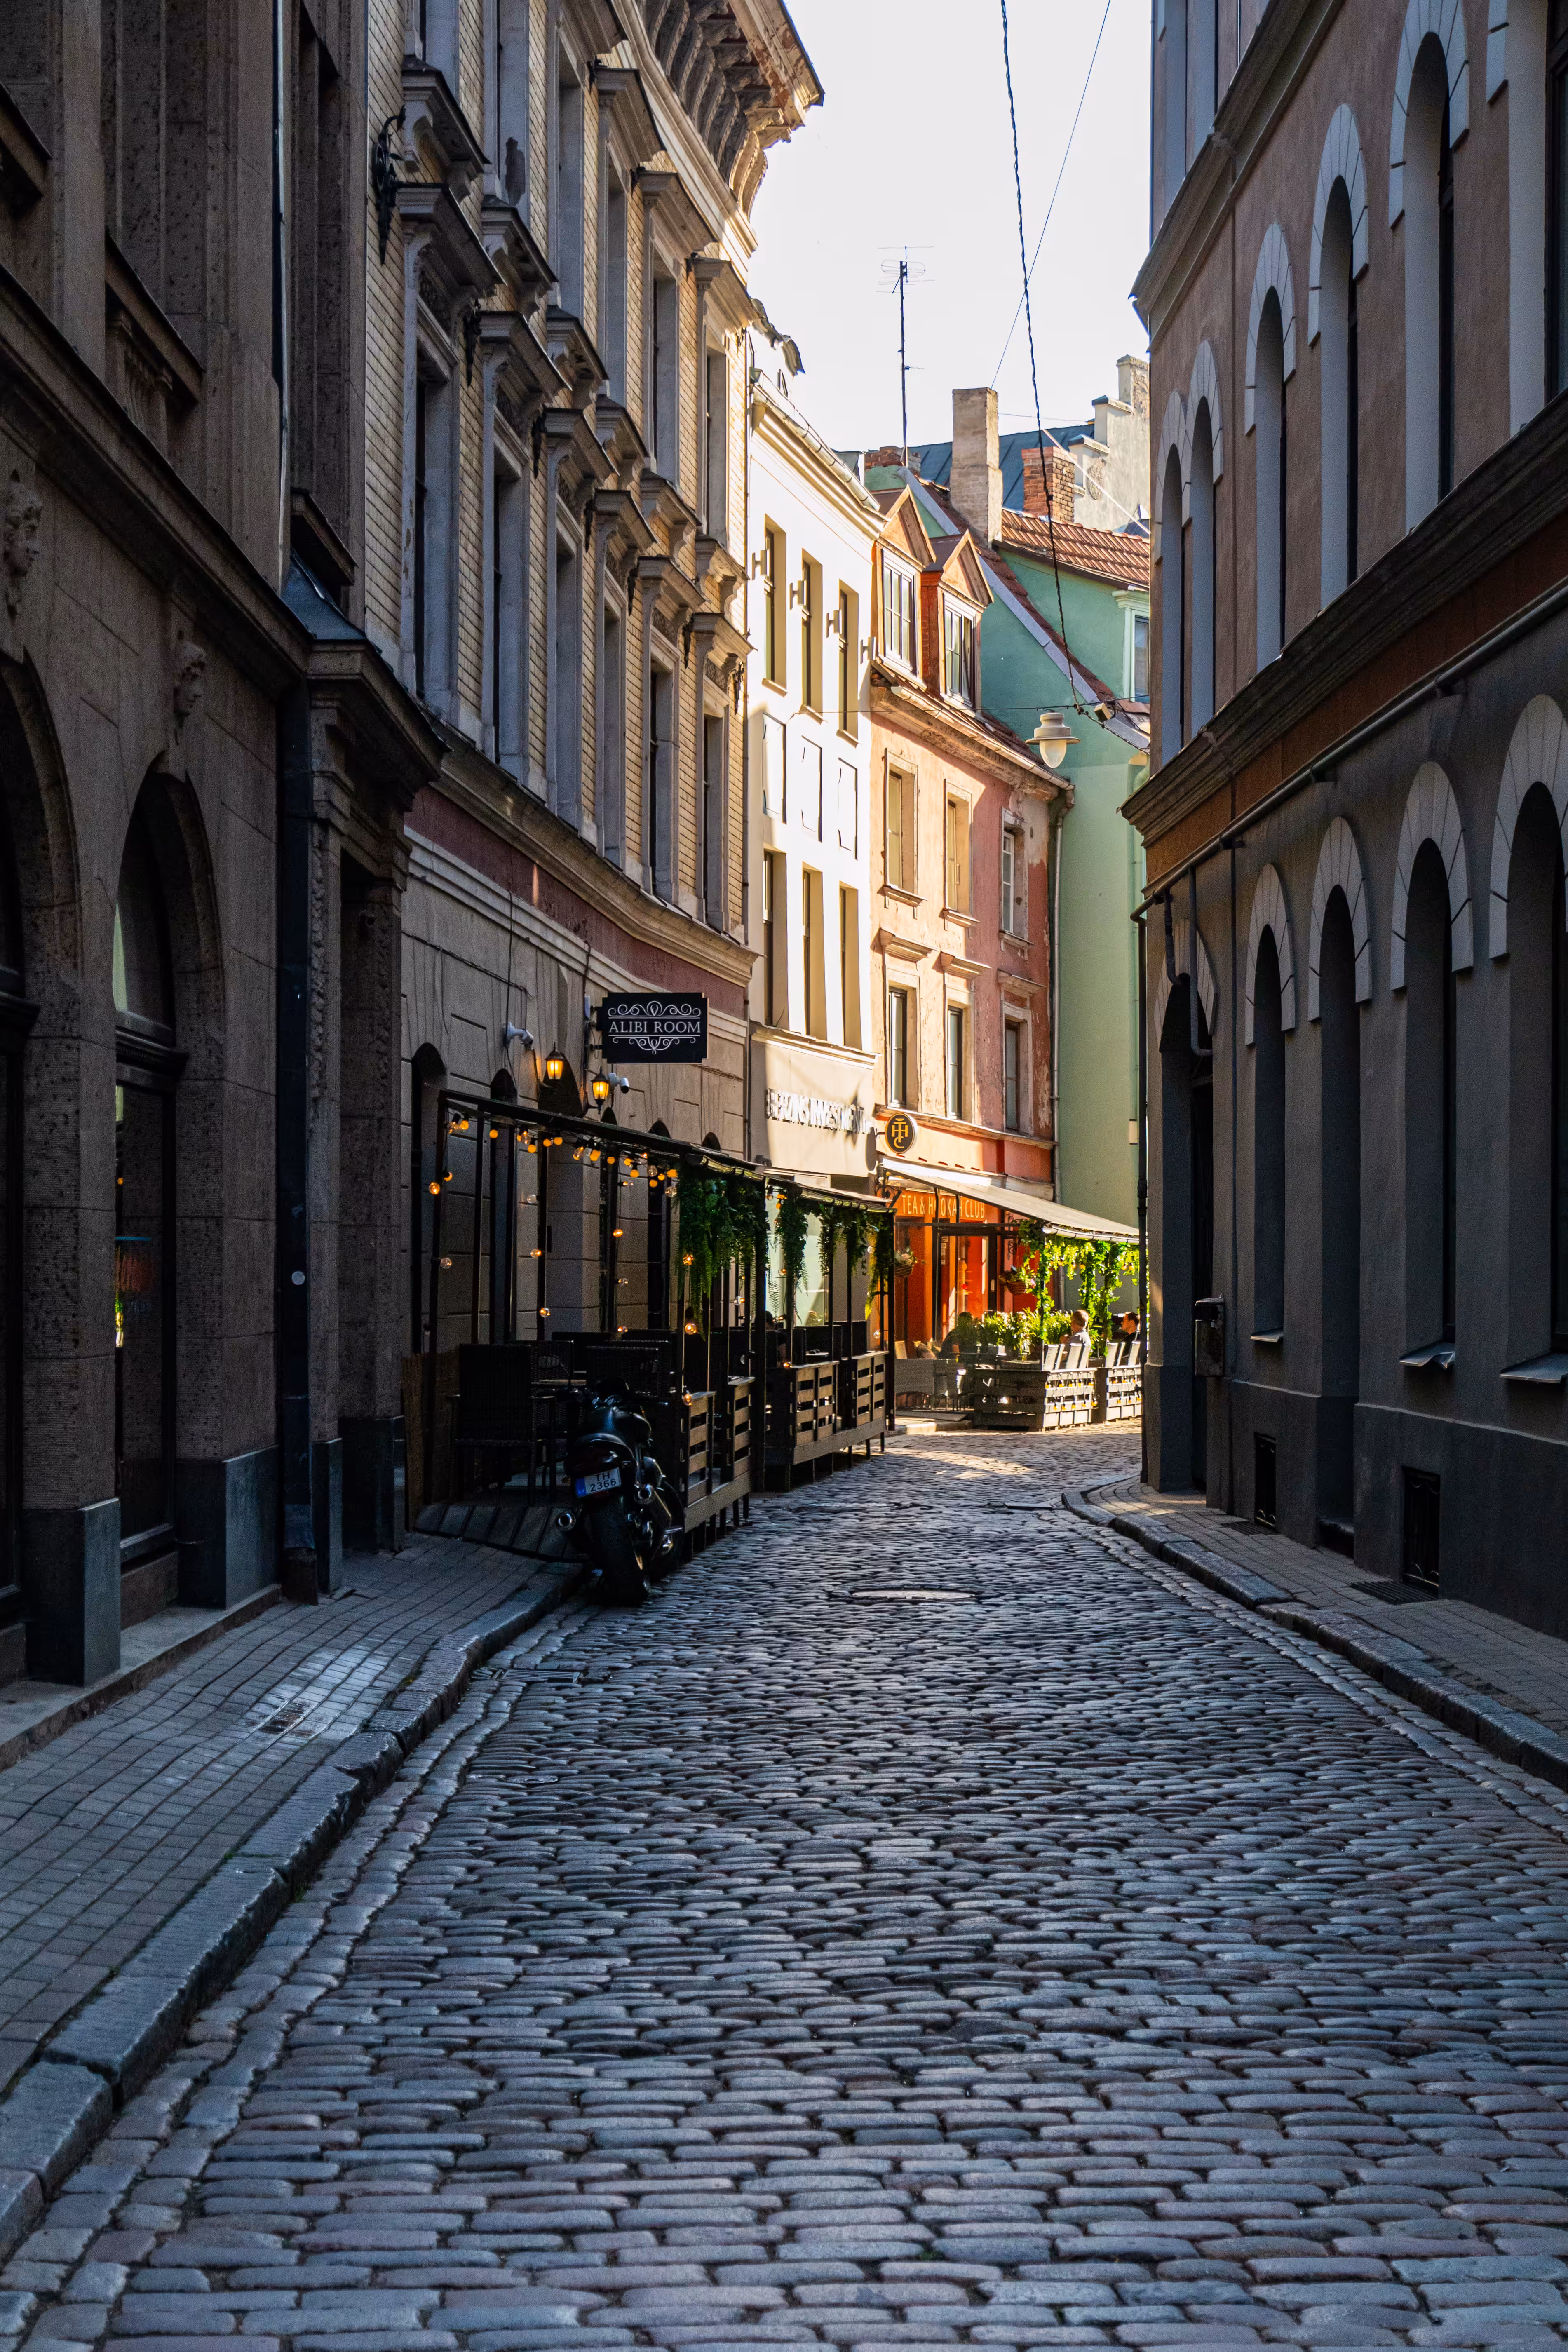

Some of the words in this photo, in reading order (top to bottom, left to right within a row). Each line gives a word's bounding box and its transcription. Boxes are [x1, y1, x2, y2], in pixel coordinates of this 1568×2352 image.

[609, 1021, 648, 1033] ALIBI
[654, 1021, 701, 1033] ROOM
[901, 1195, 918, 1214] TEA
[920, 1196, 926, 1215] &
[928, 1197, 963, 1217] HOKAH
[965, 1199, 985, 1218] CLUB
[594, 1472, 610, 1482] TH
[589, 1478, 617, 1492] 2366
